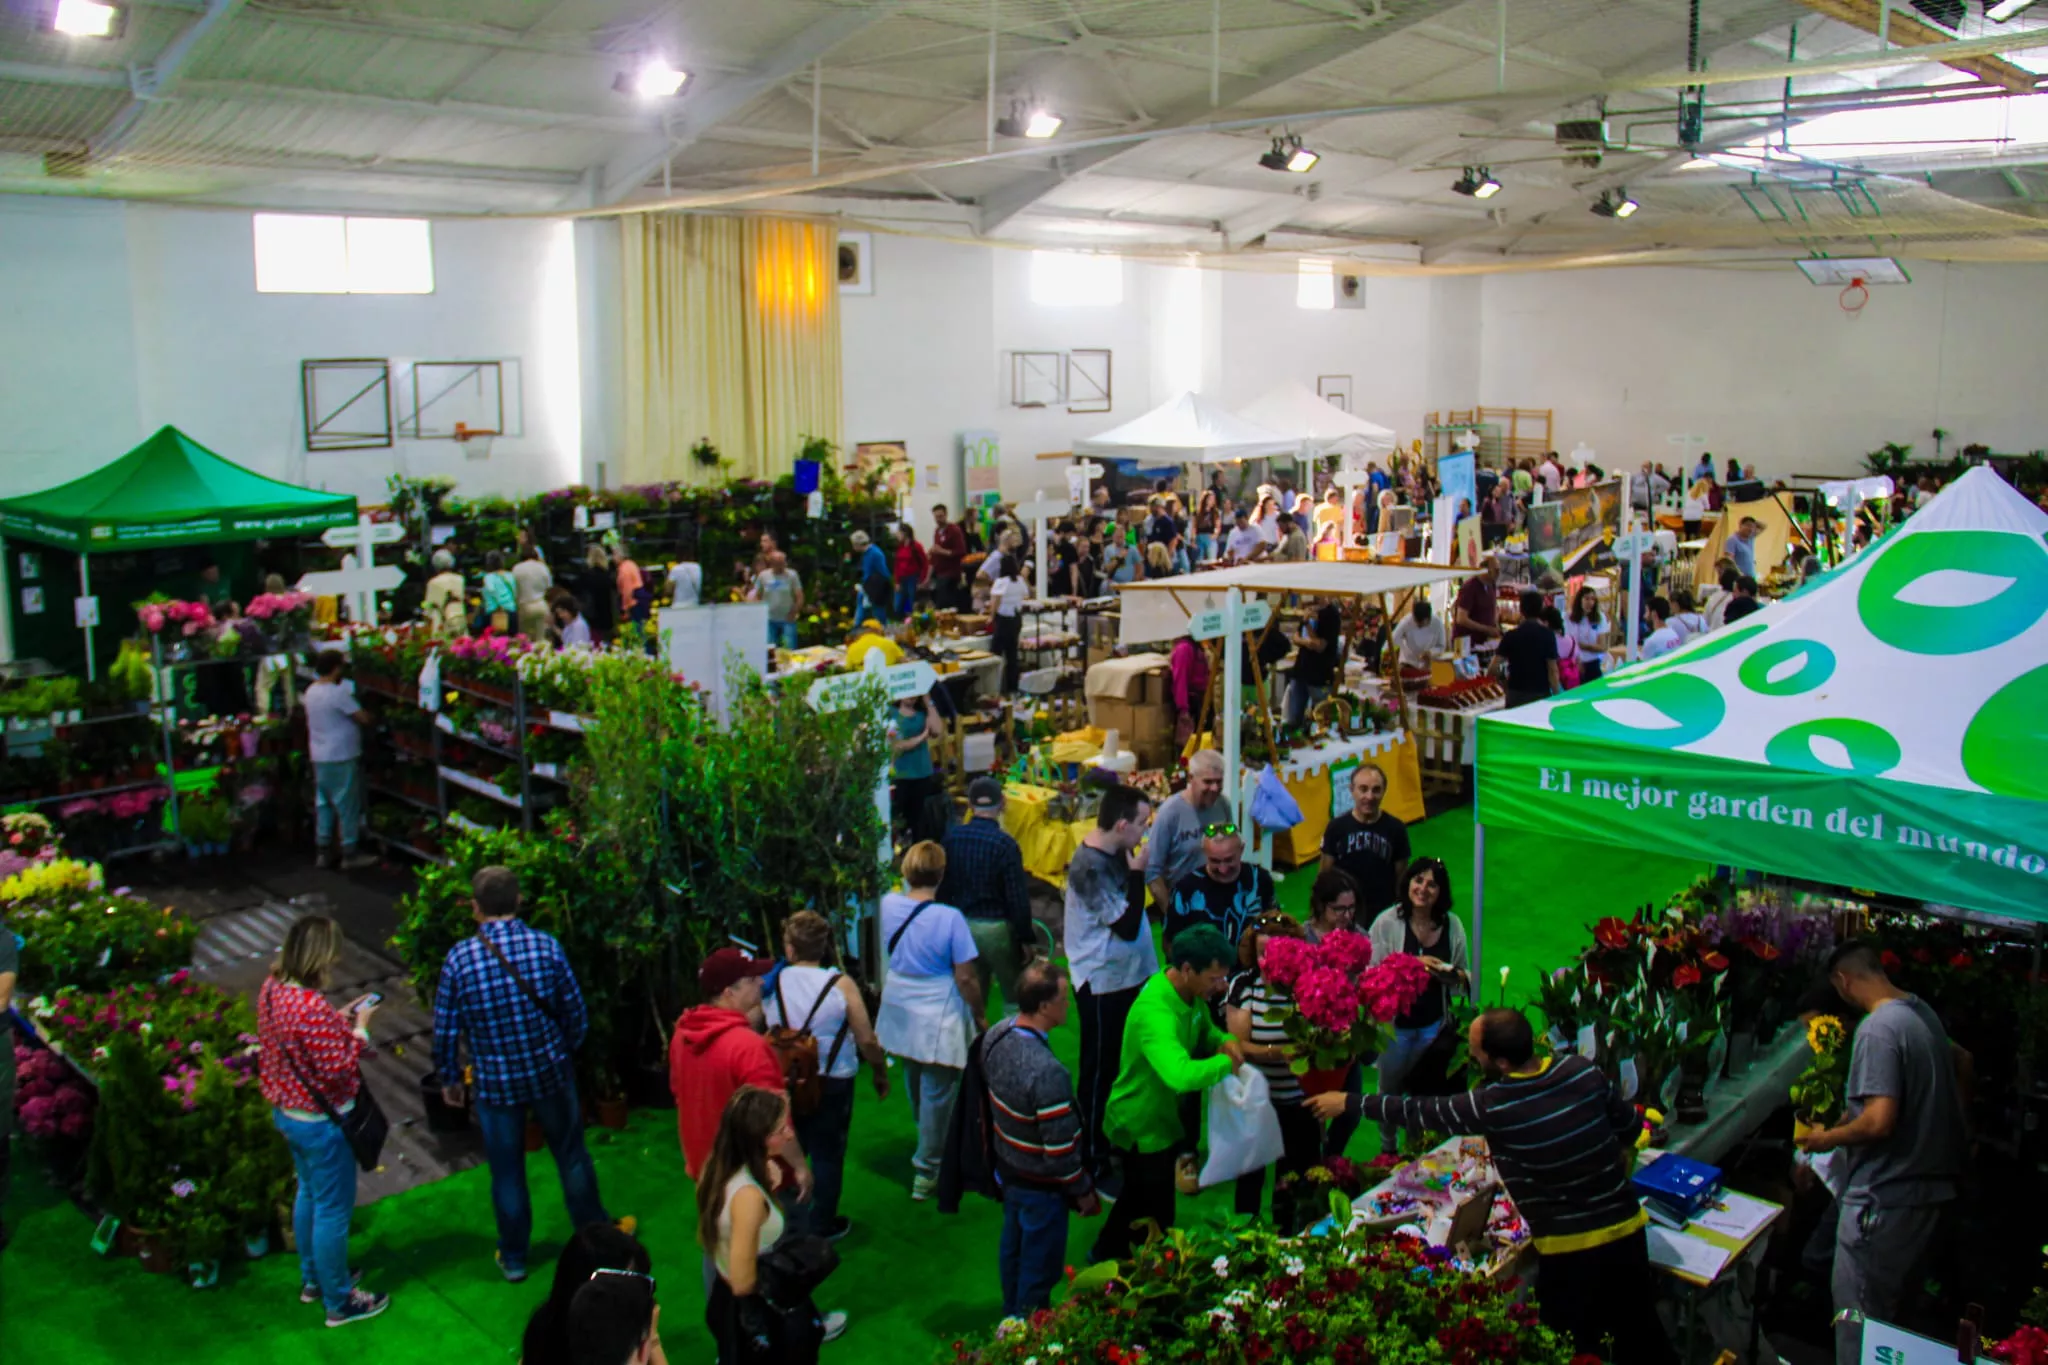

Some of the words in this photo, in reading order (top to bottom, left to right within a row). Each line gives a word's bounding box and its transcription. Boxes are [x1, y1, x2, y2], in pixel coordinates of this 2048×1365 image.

[1538, 766, 1572, 793] El
[1581, 778, 1679, 810] mejor
[1688, 791, 1814, 830] garden
[1825, 807, 1884, 841] del
[1896, 824, 2047, 875] mundo
